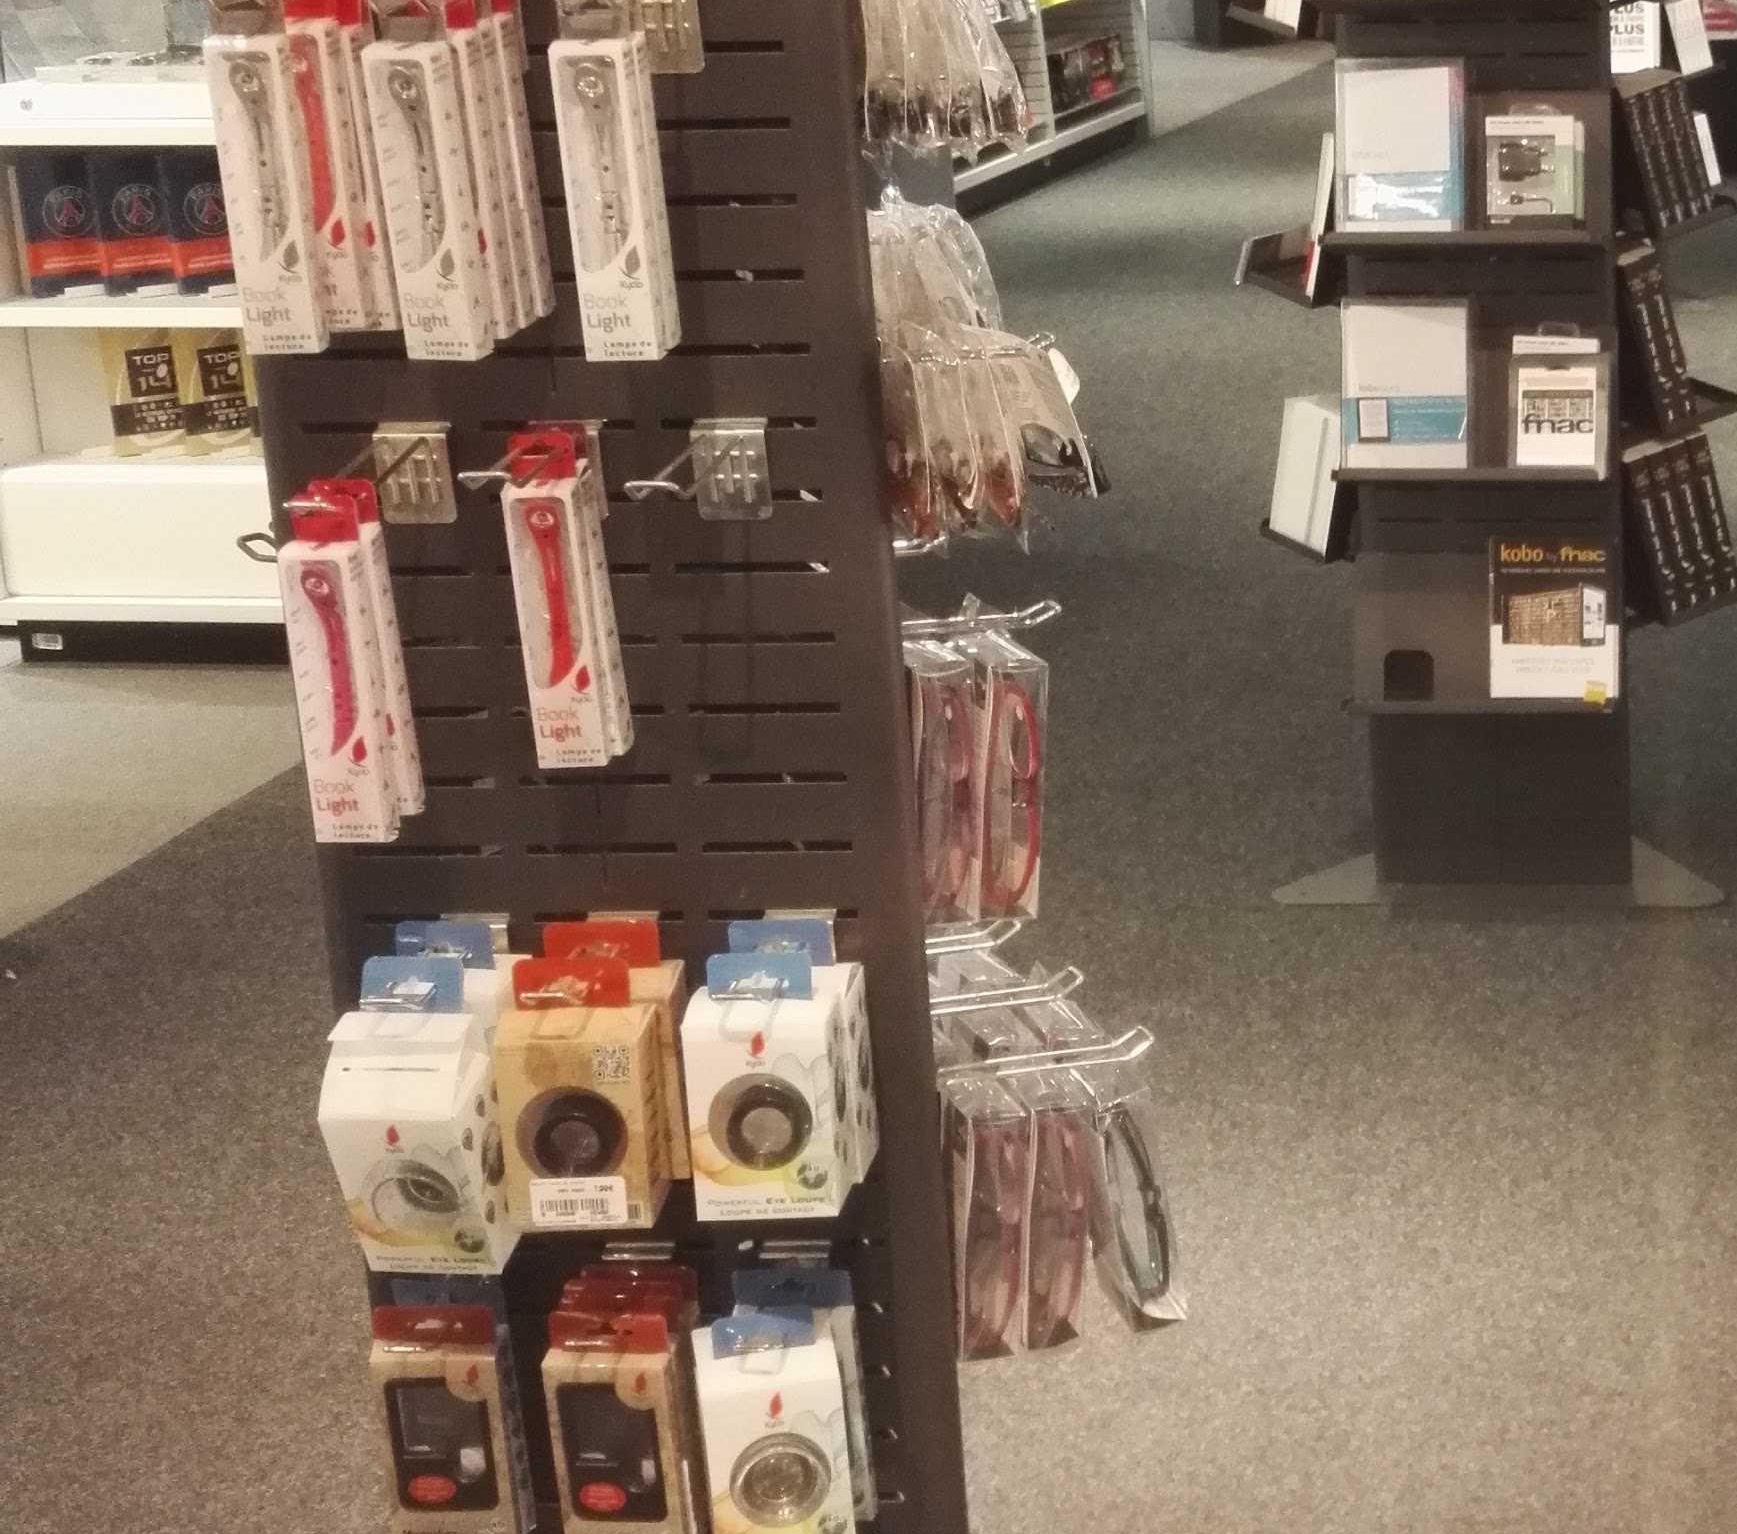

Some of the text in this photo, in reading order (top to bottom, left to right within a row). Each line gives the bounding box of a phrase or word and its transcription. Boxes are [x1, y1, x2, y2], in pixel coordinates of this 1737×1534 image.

[242, 286, 285, 303] Book
[403, 292, 445, 309] Book
[583, 292, 627, 310] Book
[245, 305, 291, 327] Light
[406, 312, 450, 333] Light
[586, 312, 632, 333] Light
[131, 353, 170, 365] TOP
[1521, 412, 1594, 435] fnac
[1500, 543, 1544, 562] kobo
[1560, 545, 1606, 562] fnac
[536, 706, 580, 722] Book
[539, 723, 583, 743] Light
[313, 778, 355, 794] Book
[316, 796, 360, 817] Light
